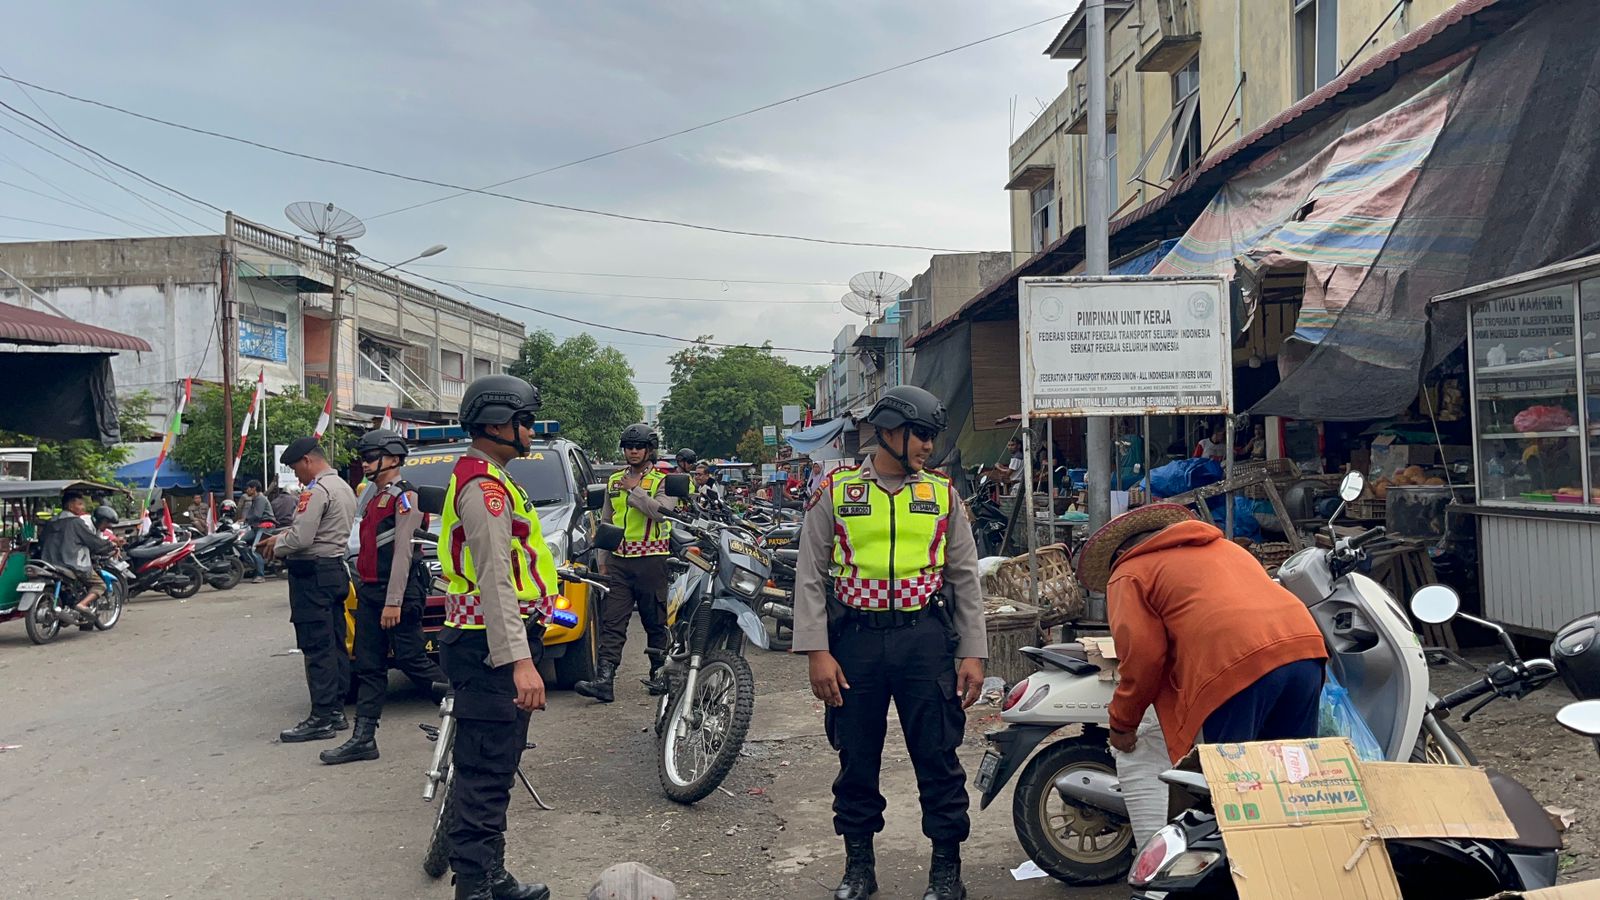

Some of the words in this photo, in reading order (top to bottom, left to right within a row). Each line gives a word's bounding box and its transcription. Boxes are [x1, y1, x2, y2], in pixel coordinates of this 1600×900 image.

[1077, 311, 1118, 326] PIMPINAN
[1120, 310, 1141, 325] UNIT
[1143, 309, 1172, 325] KERJA
[1038, 331, 1066, 342] FEDERASI
[1067, 331, 1091, 341] SERIKAT
[1092, 330, 1117, 341] PEKERJA
[1119, 330, 1152, 340] TRANSPORT
[1153, 329, 1179, 339] SELURUH
[1181, 328, 1211, 339] INDONESIA
[1070, 343, 1094, 353] SERIKAT
[1095, 342, 1121, 353] PEKERJA
[1122, 342, 1148, 352] SELURUH
[1149, 341, 1180, 352] INDONESIA
[1067, 373, 1073, 382] OF
[1074, 372, 1100, 382] TRANSPORT
[1100, 372, 1121, 381] WORKERS
[1122, 371, 1136, 381] UNION
[1139, 371, 1147, 380] ALL
[1148, 370, 1174, 380] INDONESIAN
[1127, 397, 1145, 407] BLANG
[1195, 395, 1217, 405] LANGSA
[1288, 790, 1343, 807] Miyako
